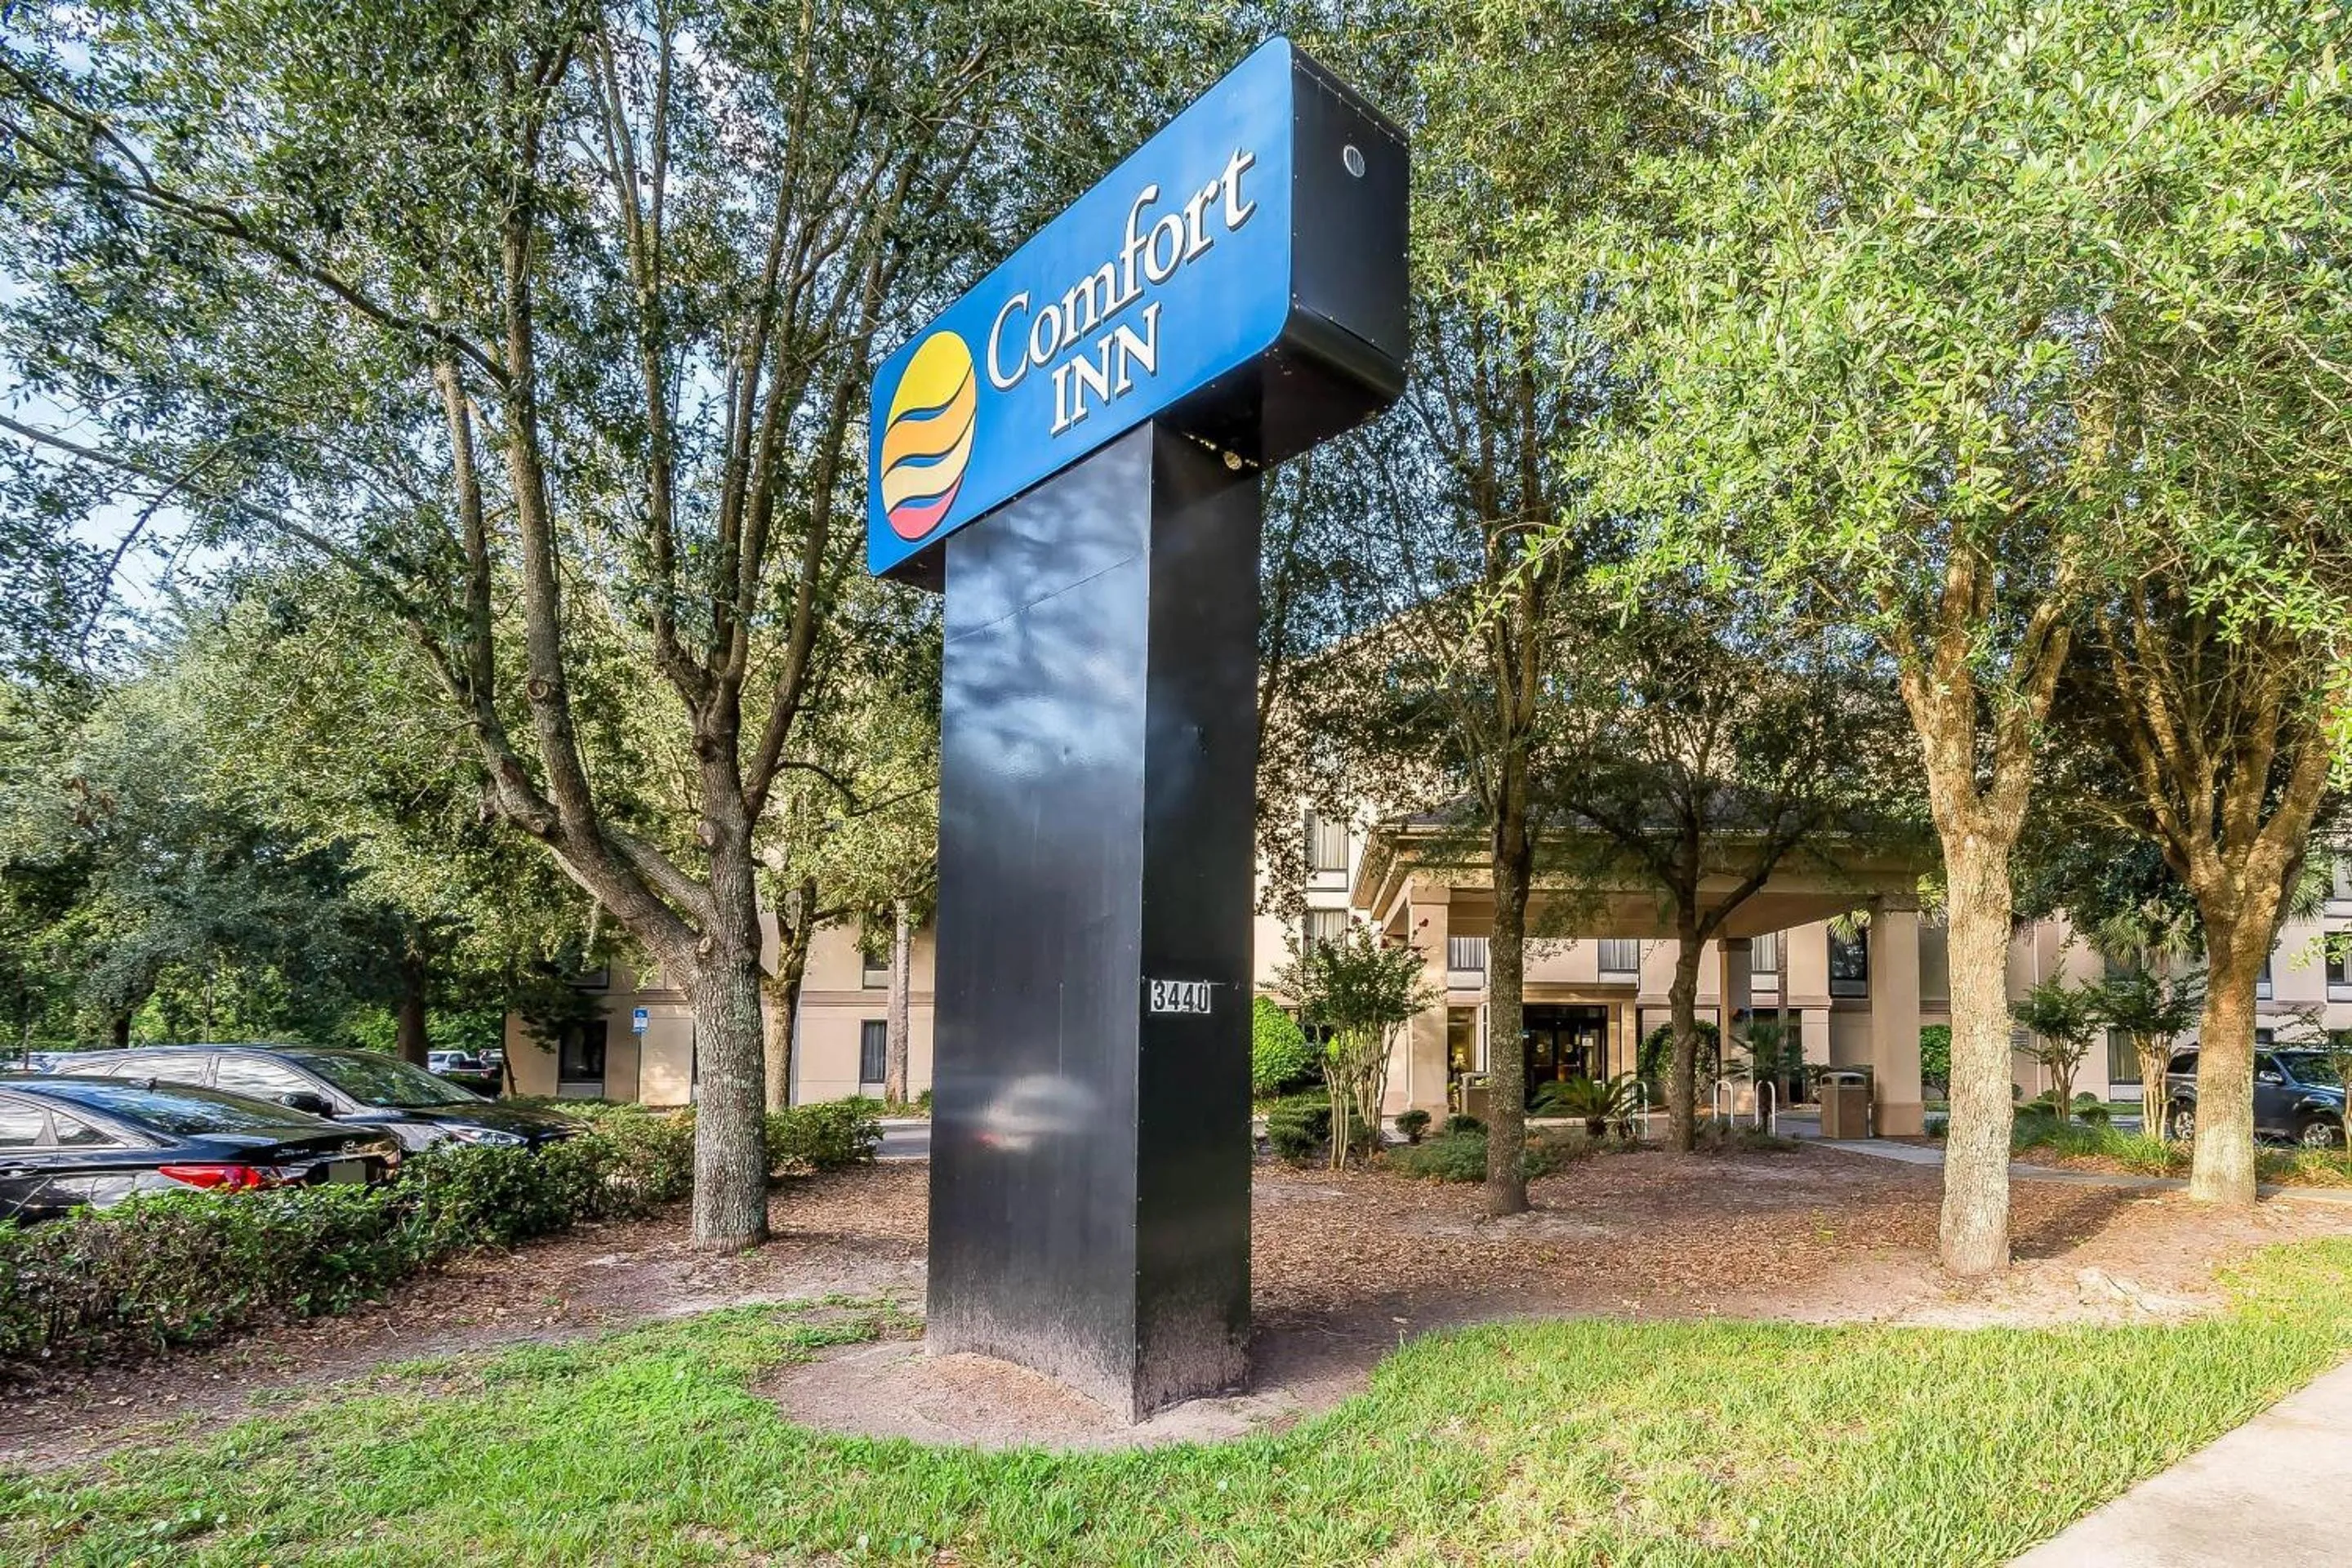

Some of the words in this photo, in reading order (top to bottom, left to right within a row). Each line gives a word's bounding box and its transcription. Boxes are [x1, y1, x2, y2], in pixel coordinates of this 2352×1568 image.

[987, 147, 1256, 390] Comfort
[1049, 301, 1160, 435] INN
[1153, 980, 1209, 1012] 3440
